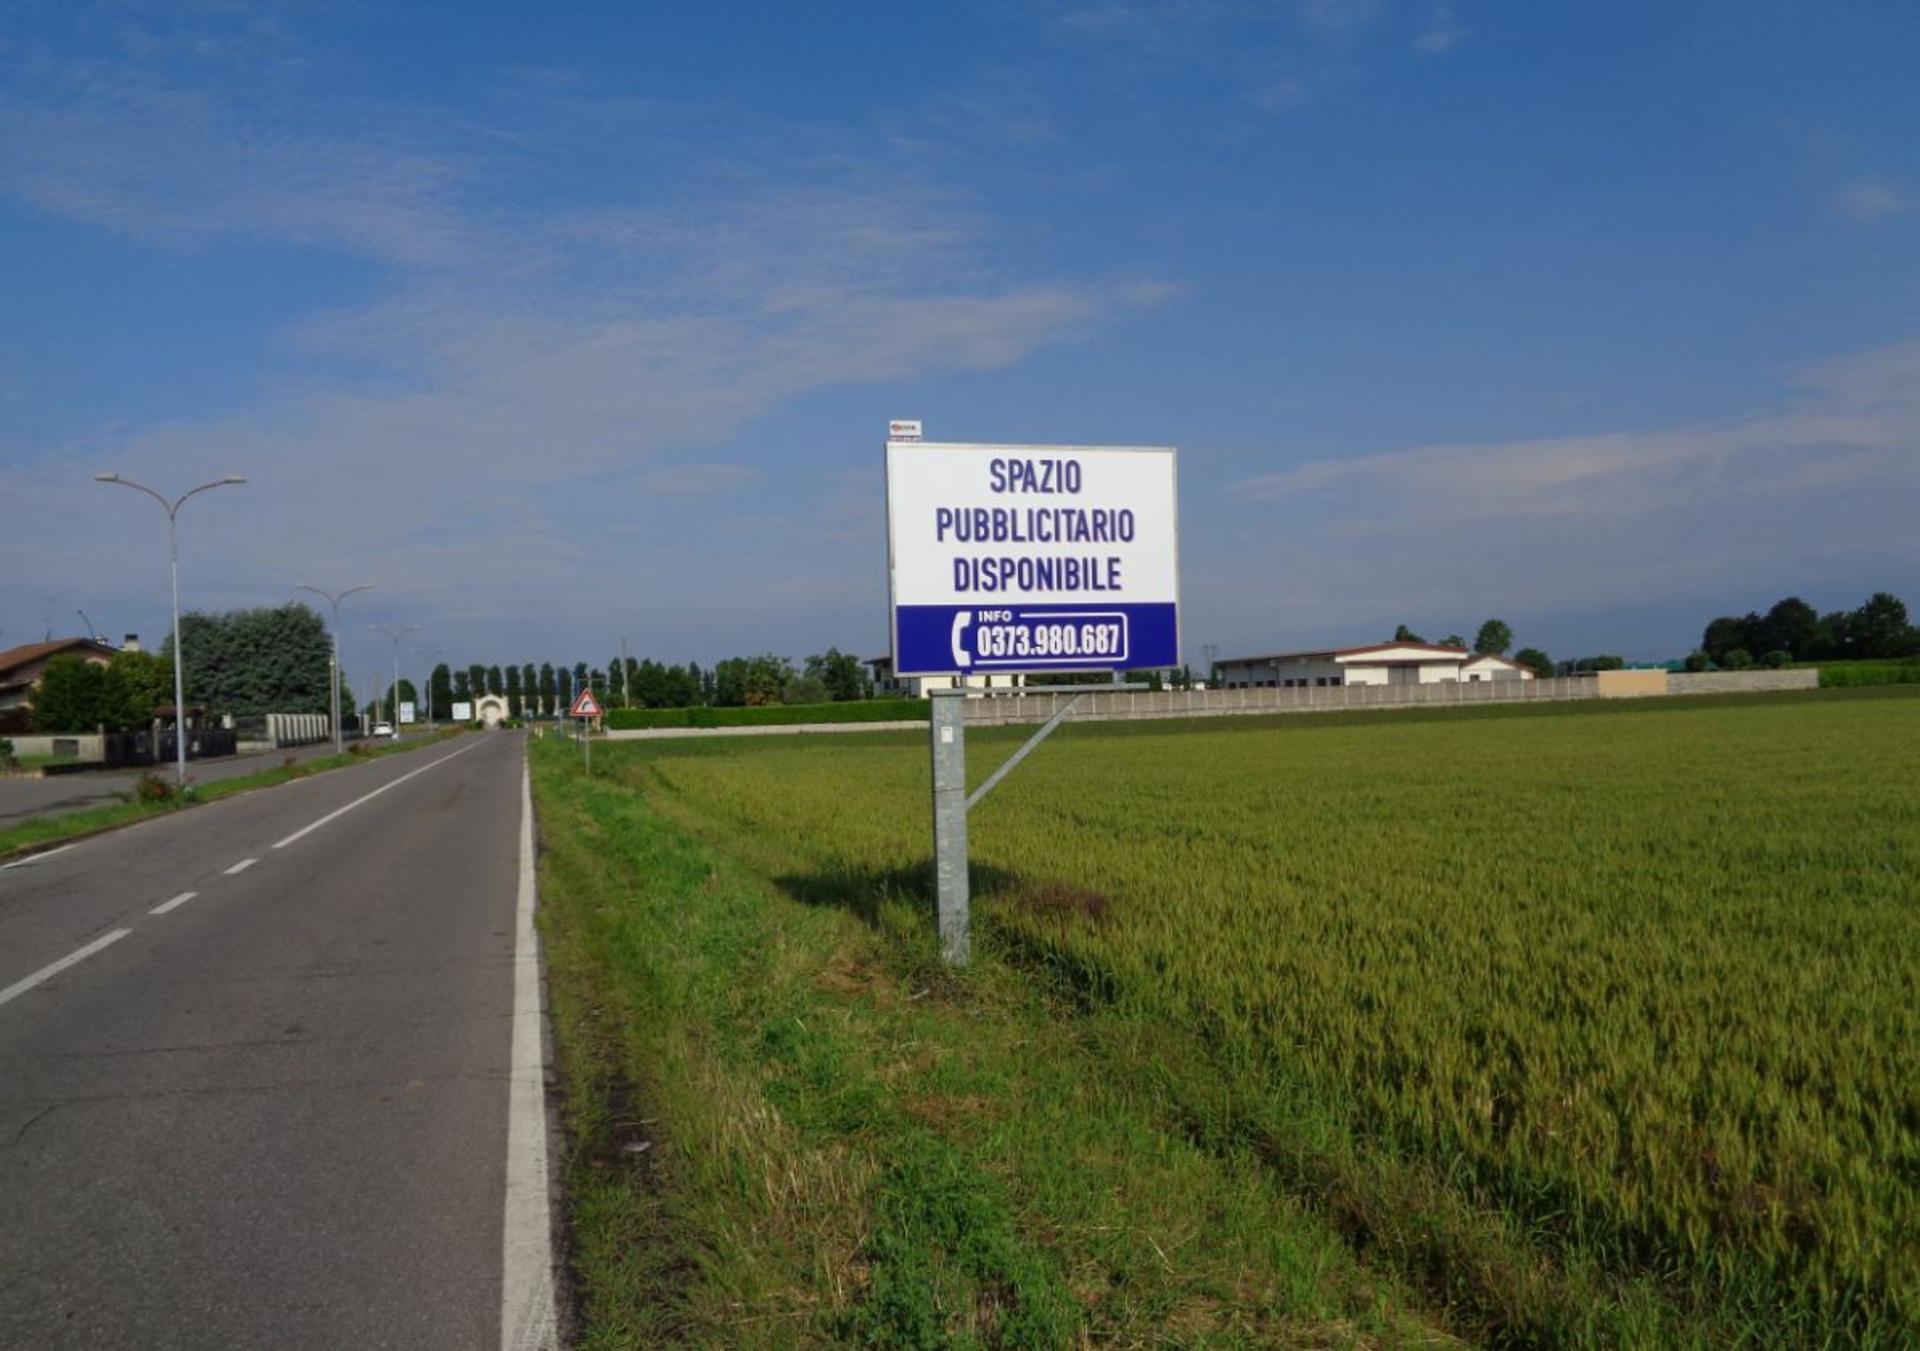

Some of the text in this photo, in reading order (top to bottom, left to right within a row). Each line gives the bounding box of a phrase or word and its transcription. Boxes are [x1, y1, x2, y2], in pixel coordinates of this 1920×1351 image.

[990, 458, 1081, 493] SPAZIO
[936, 508, 1134, 542] PUBBLICITARIO
[953, 557, 1121, 591] DISPONIBILE
[978, 611, 1012, 622] INFO
[976, 624, 1120, 656] 0373.980.687
